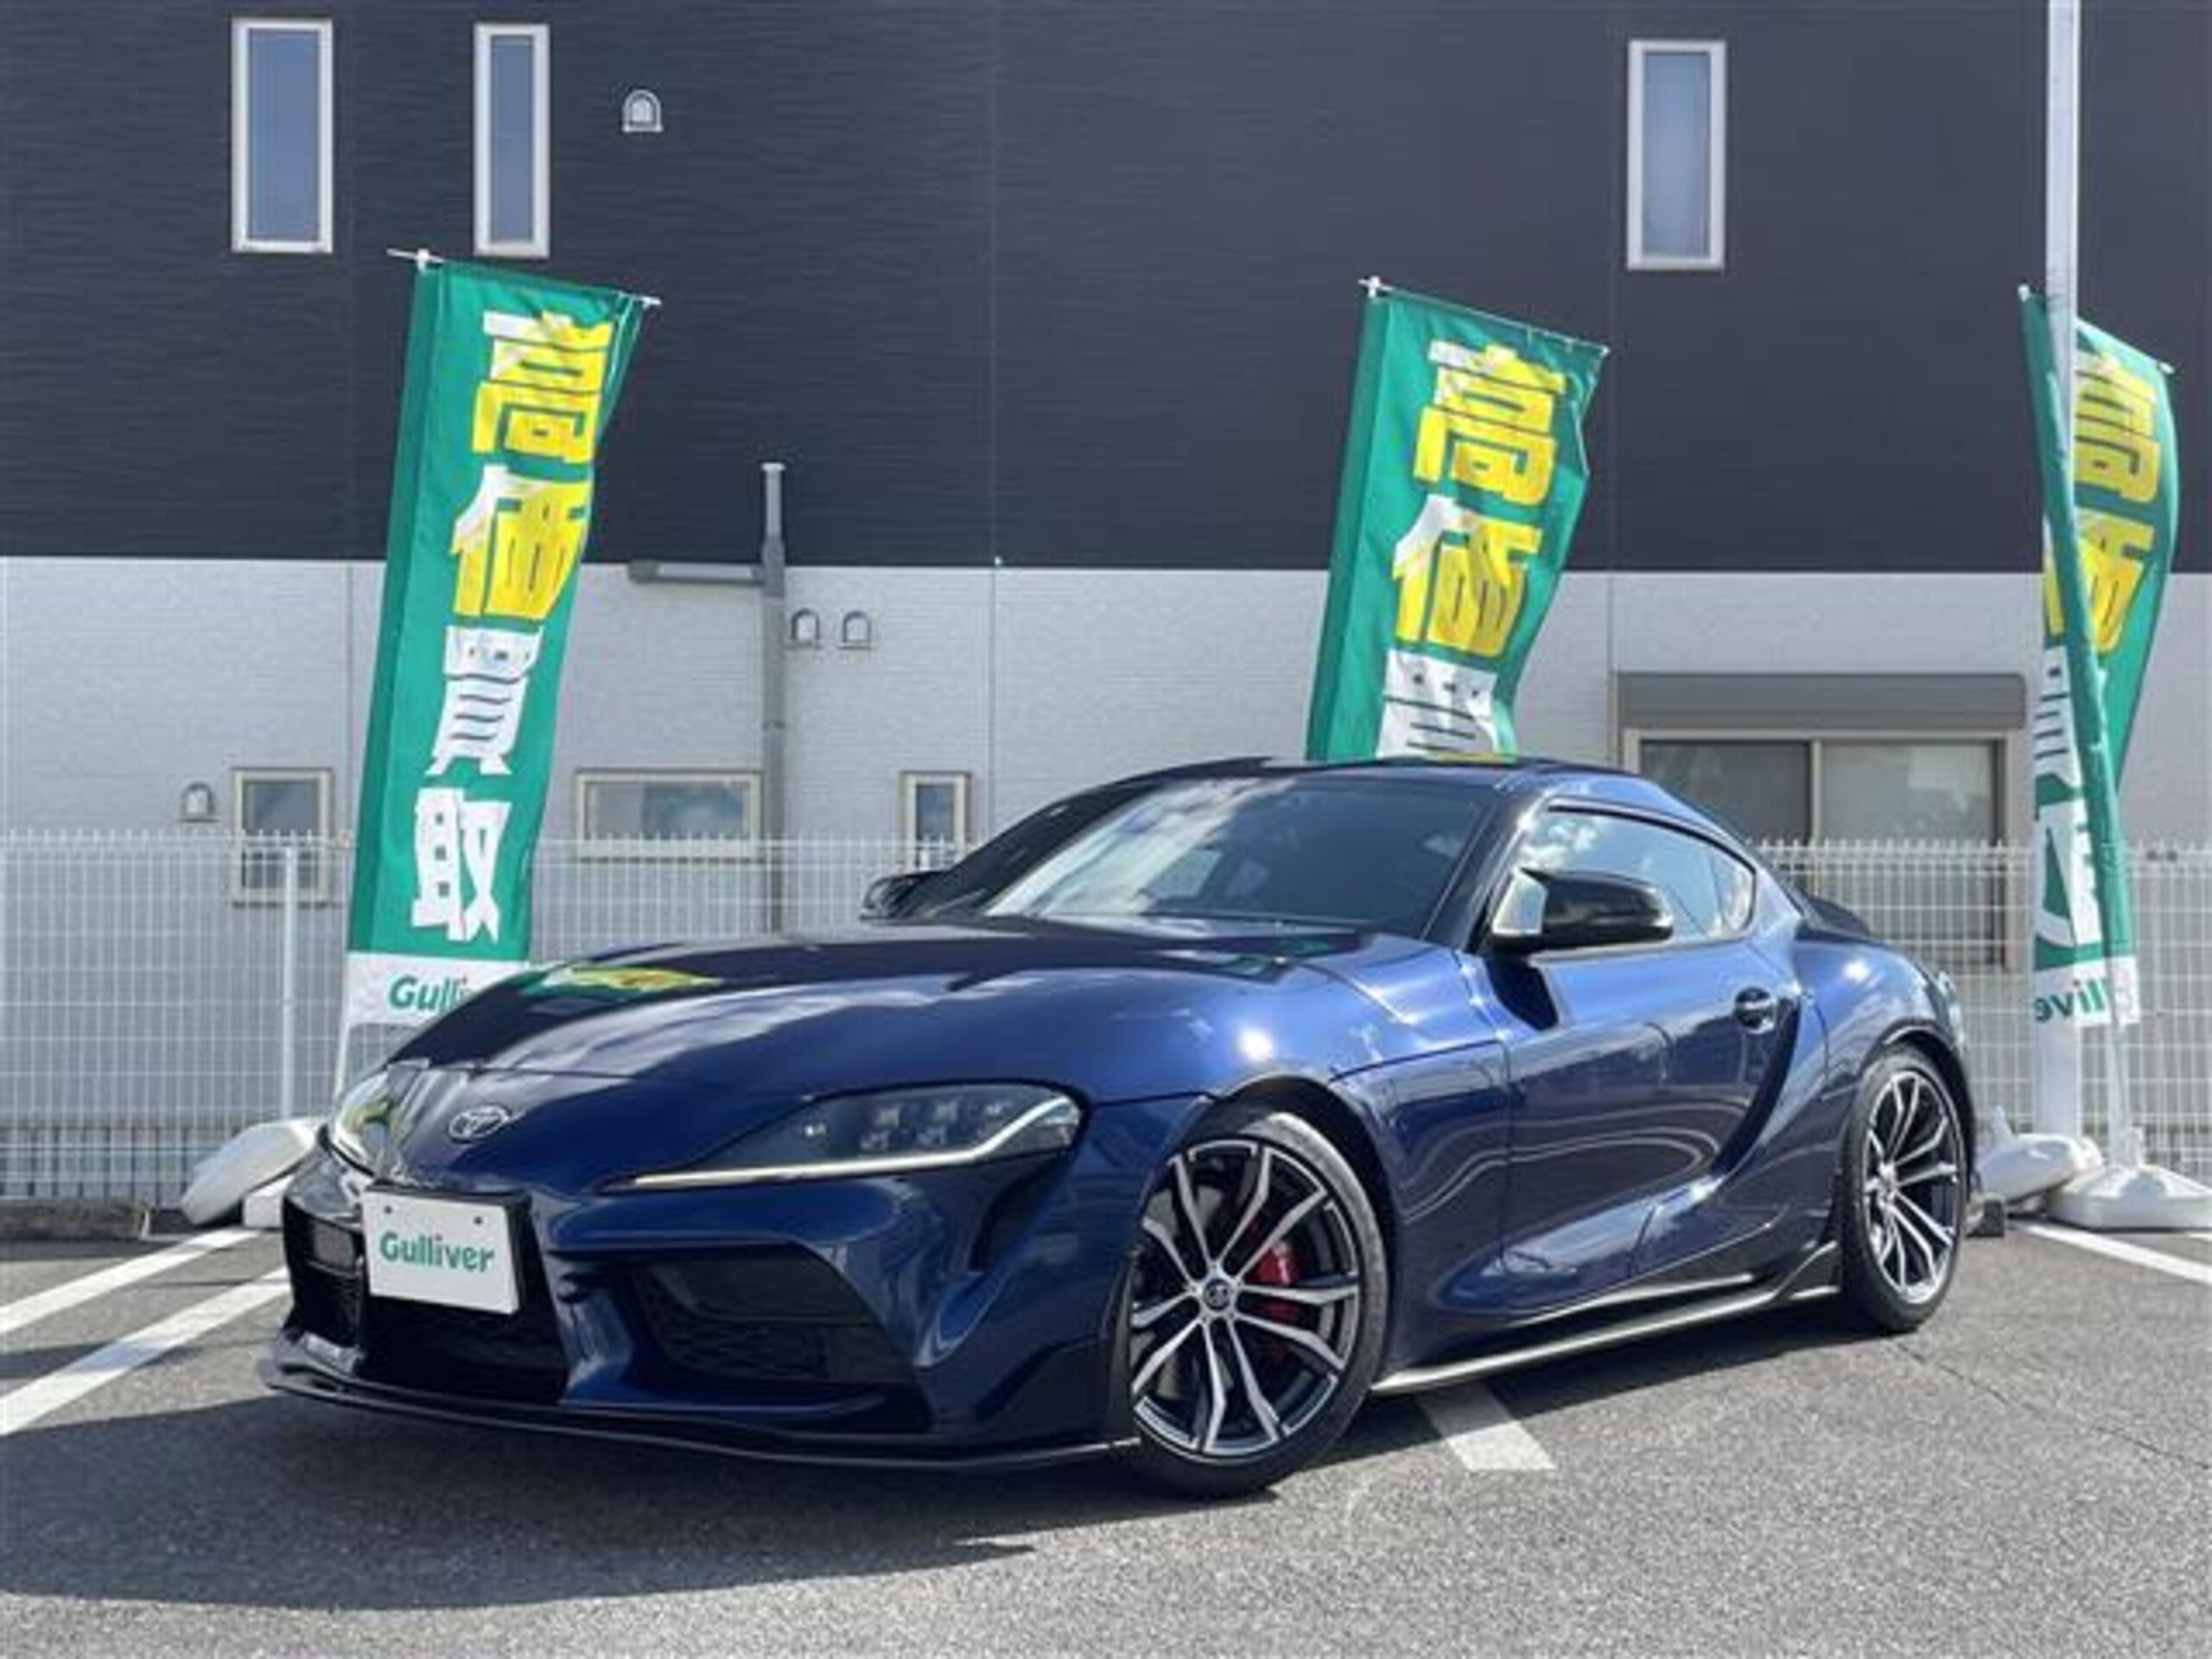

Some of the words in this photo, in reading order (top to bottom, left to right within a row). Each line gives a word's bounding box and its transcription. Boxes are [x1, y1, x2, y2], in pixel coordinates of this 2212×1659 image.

[410, 309, 613, 944] 高価買取
[380, 1232, 495, 1273] Gulliver
